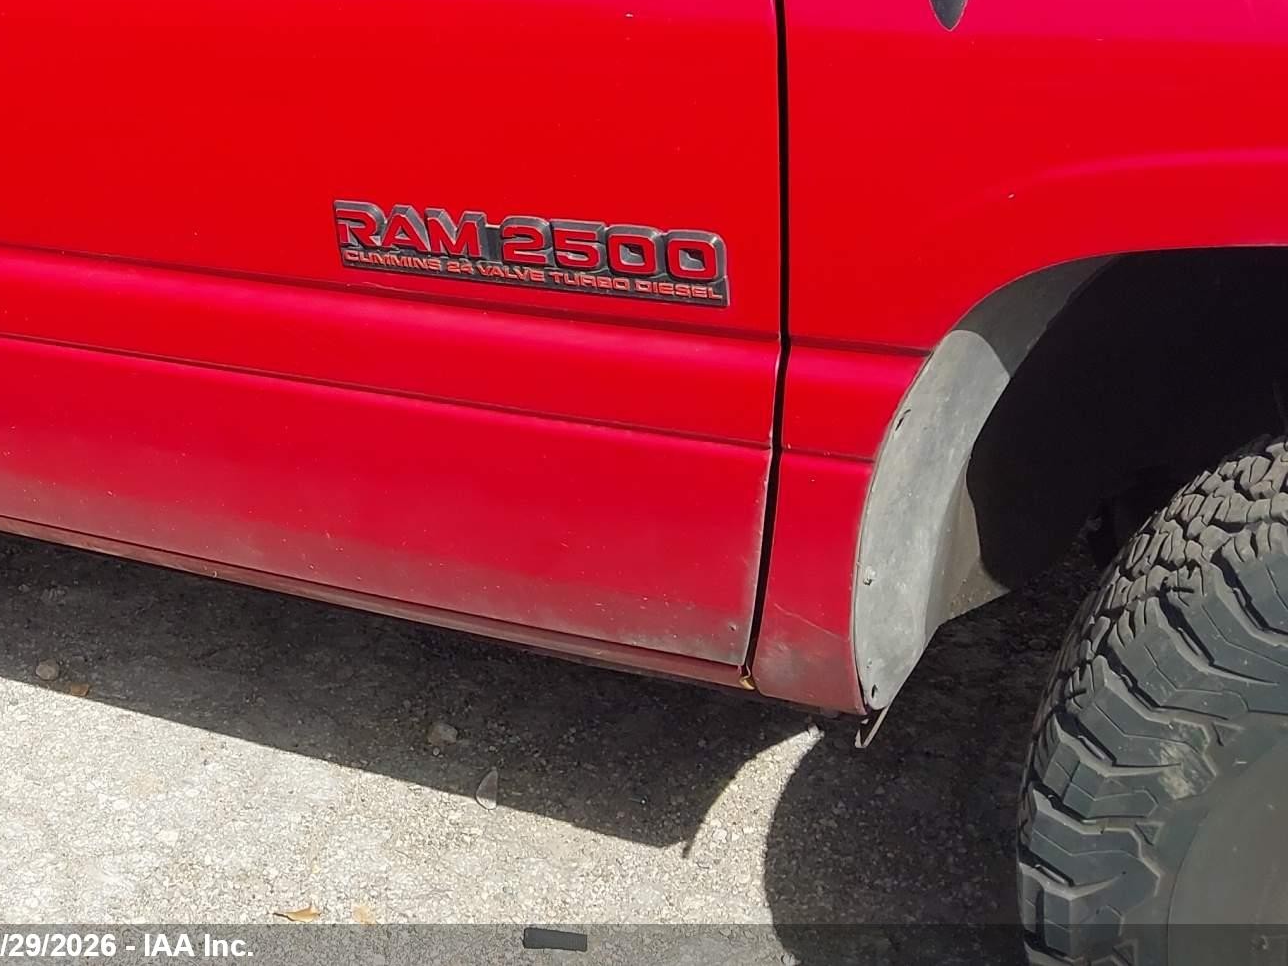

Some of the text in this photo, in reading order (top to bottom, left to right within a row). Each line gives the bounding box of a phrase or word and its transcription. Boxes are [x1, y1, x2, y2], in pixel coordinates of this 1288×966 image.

[334, 202, 722, 280] RAM 2500
[344, 250, 723, 300] CUMMINS 24 VALVE TURBO DIESEL
